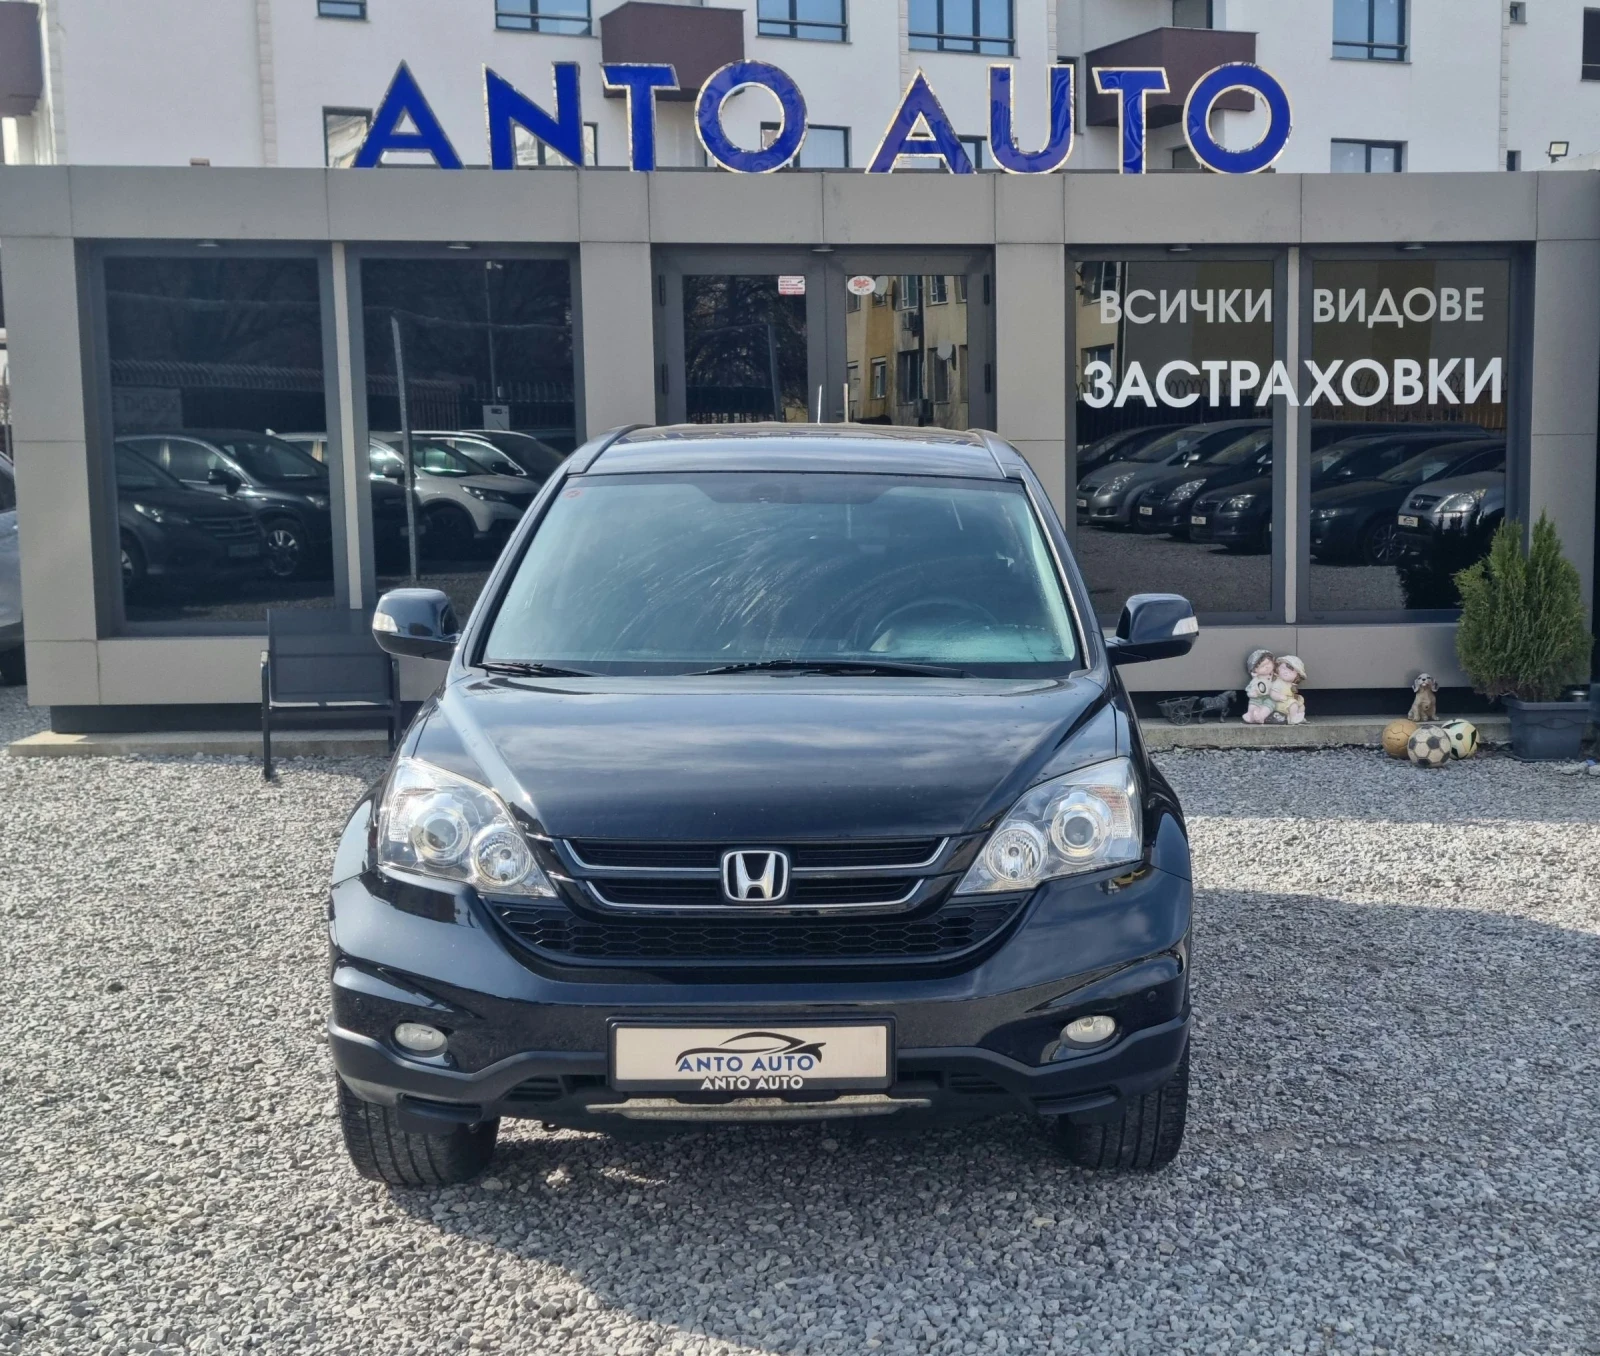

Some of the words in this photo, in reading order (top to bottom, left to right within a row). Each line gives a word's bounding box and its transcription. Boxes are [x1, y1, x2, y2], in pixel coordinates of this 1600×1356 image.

[354, 60, 808, 174] ANTO
[864, 61, 1292, 175] AUTO
[1099, 288, 1273, 324] ВСИЧКИ
[1312, 287, 1485, 328] ВИДОВЕ
[1082, 357, 1504, 409] ЗАСТРАХОВКИ
[679, 1056, 743, 1072] ANTO
[752, 1055, 814, 1072] AUTO
[700, 1076, 751, 1090] ANTO
[755, 1076, 804, 1090] AUTO
